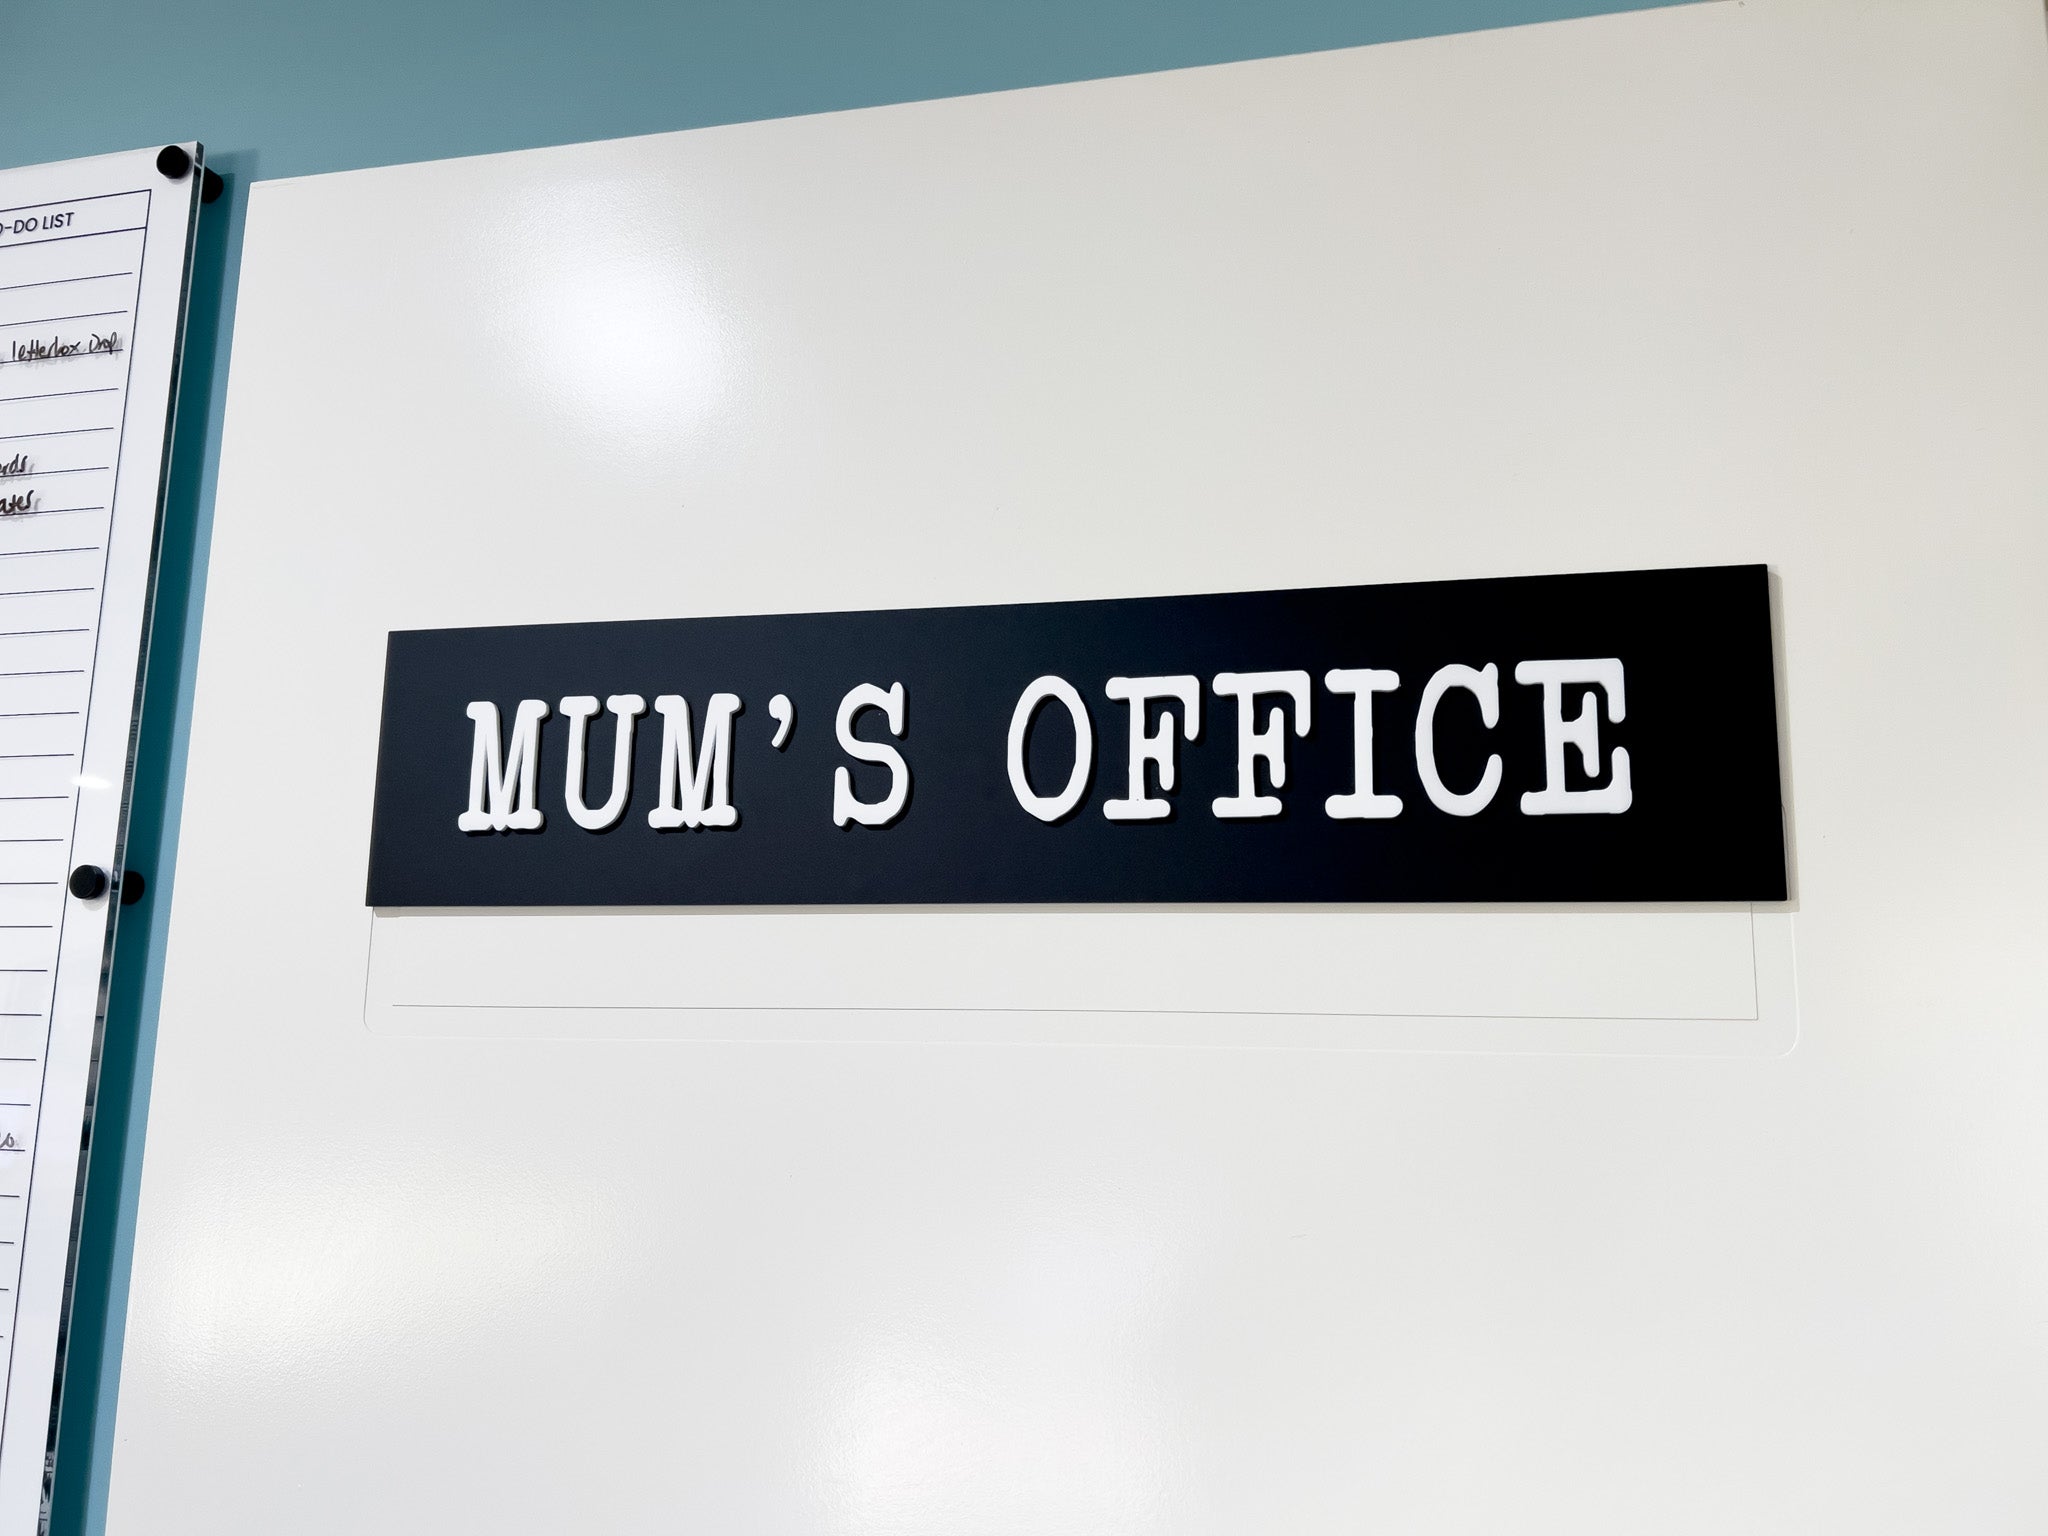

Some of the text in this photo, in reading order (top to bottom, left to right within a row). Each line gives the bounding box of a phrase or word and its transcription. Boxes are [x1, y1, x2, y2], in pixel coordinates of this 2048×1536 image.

[42, 212, 75, 230] LIST
[12, 336, 81, 362] letterbox
[458, 657, 1633, 832] MUM'S OFFICE
